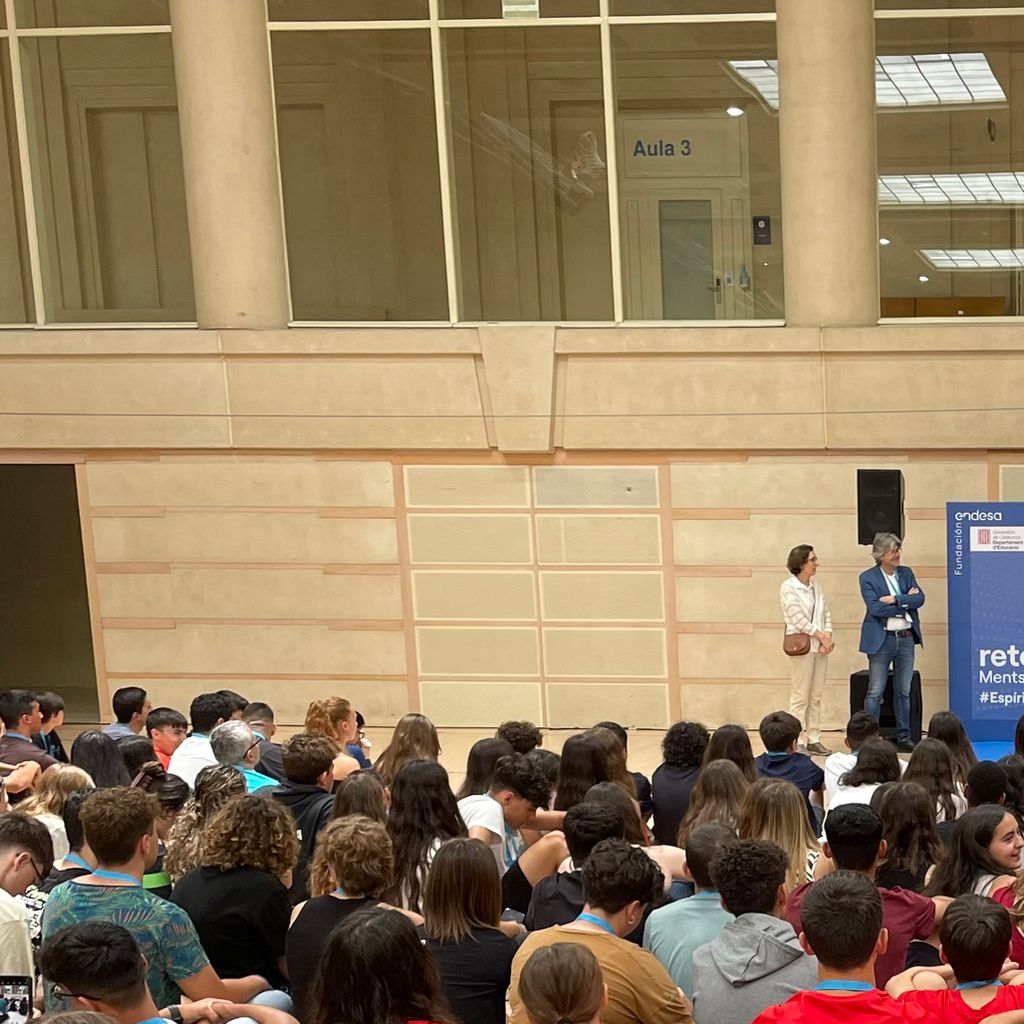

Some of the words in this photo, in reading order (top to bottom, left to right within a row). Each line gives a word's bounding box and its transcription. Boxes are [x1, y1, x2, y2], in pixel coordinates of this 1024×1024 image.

[633, 140, 675, 156] Aula
[681, 140, 692, 156] 3
[955, 510, 1002, 521] endesa
[954, 522, 963, 575] Fundación
